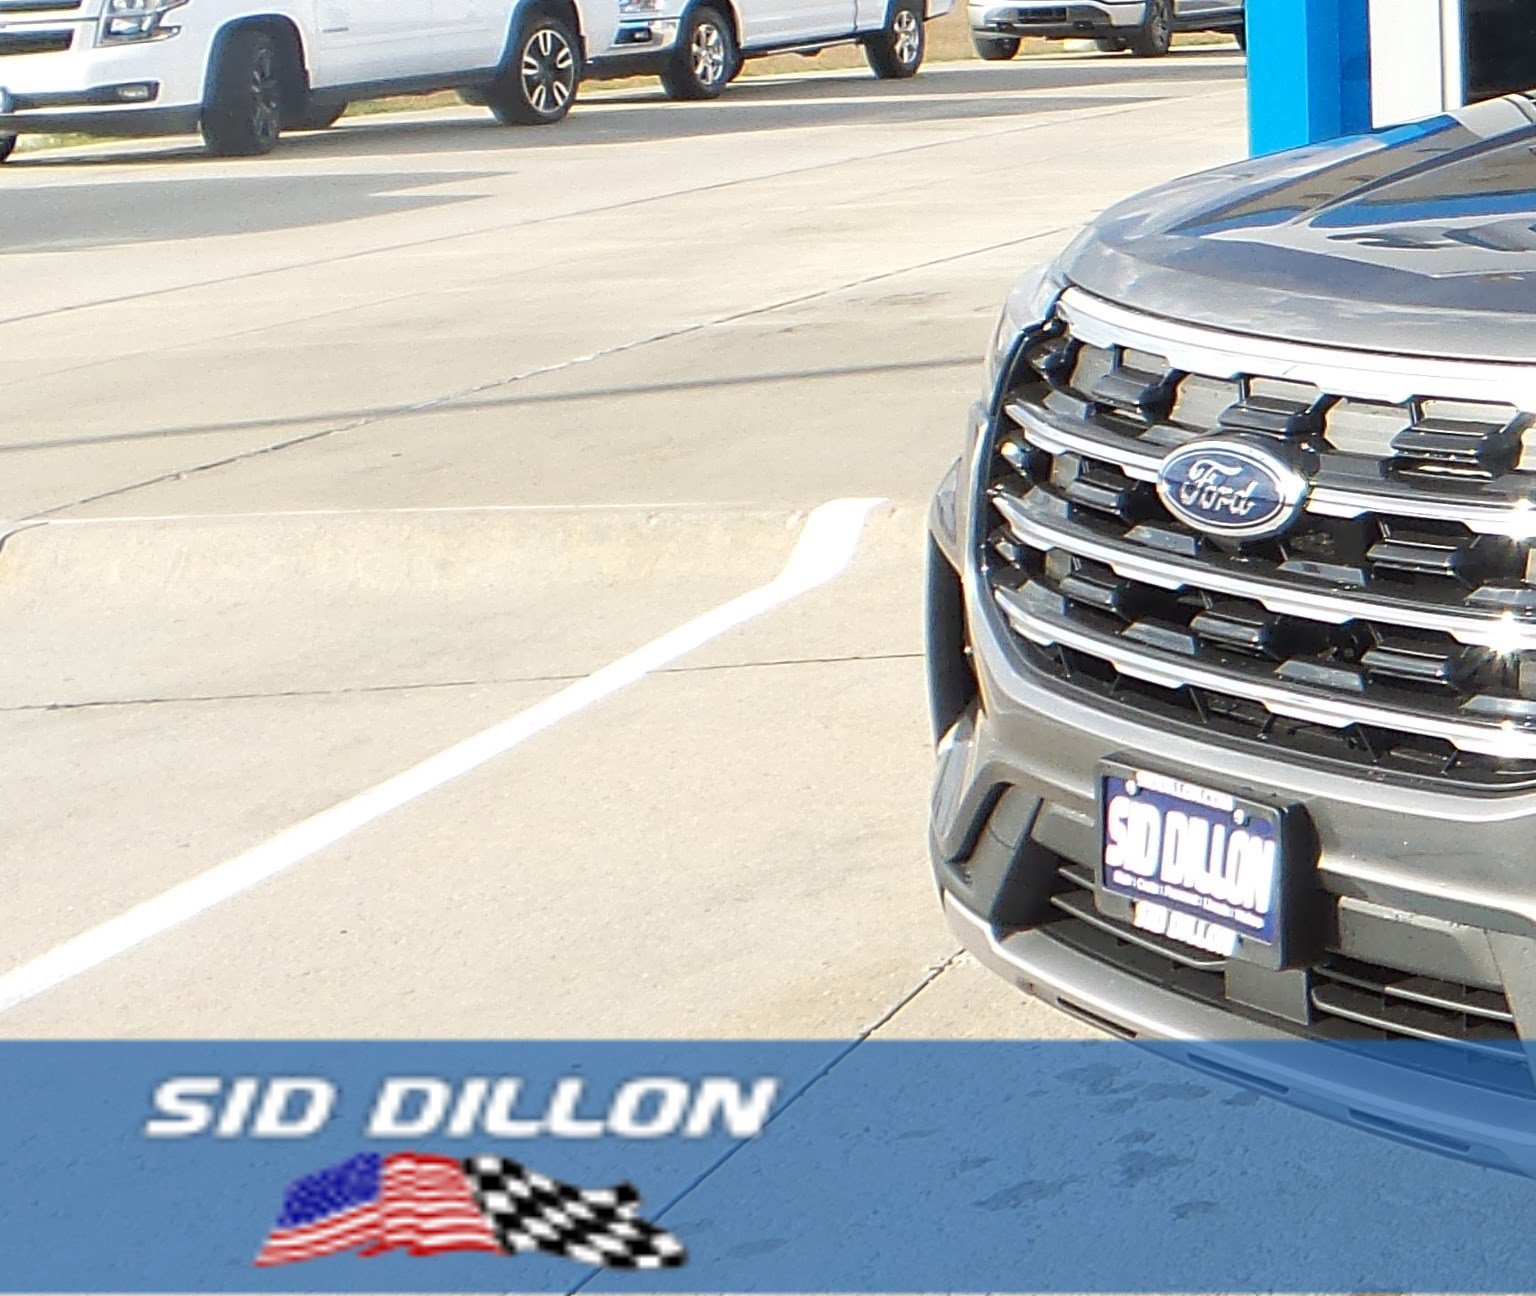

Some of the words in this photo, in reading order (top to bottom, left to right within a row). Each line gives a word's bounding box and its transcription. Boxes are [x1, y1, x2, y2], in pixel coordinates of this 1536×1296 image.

[1180, 458, 1259, 516] Ford
[1104, 795, 1162, 877] SID
[1160, 810, 1276, 914] DILLON
